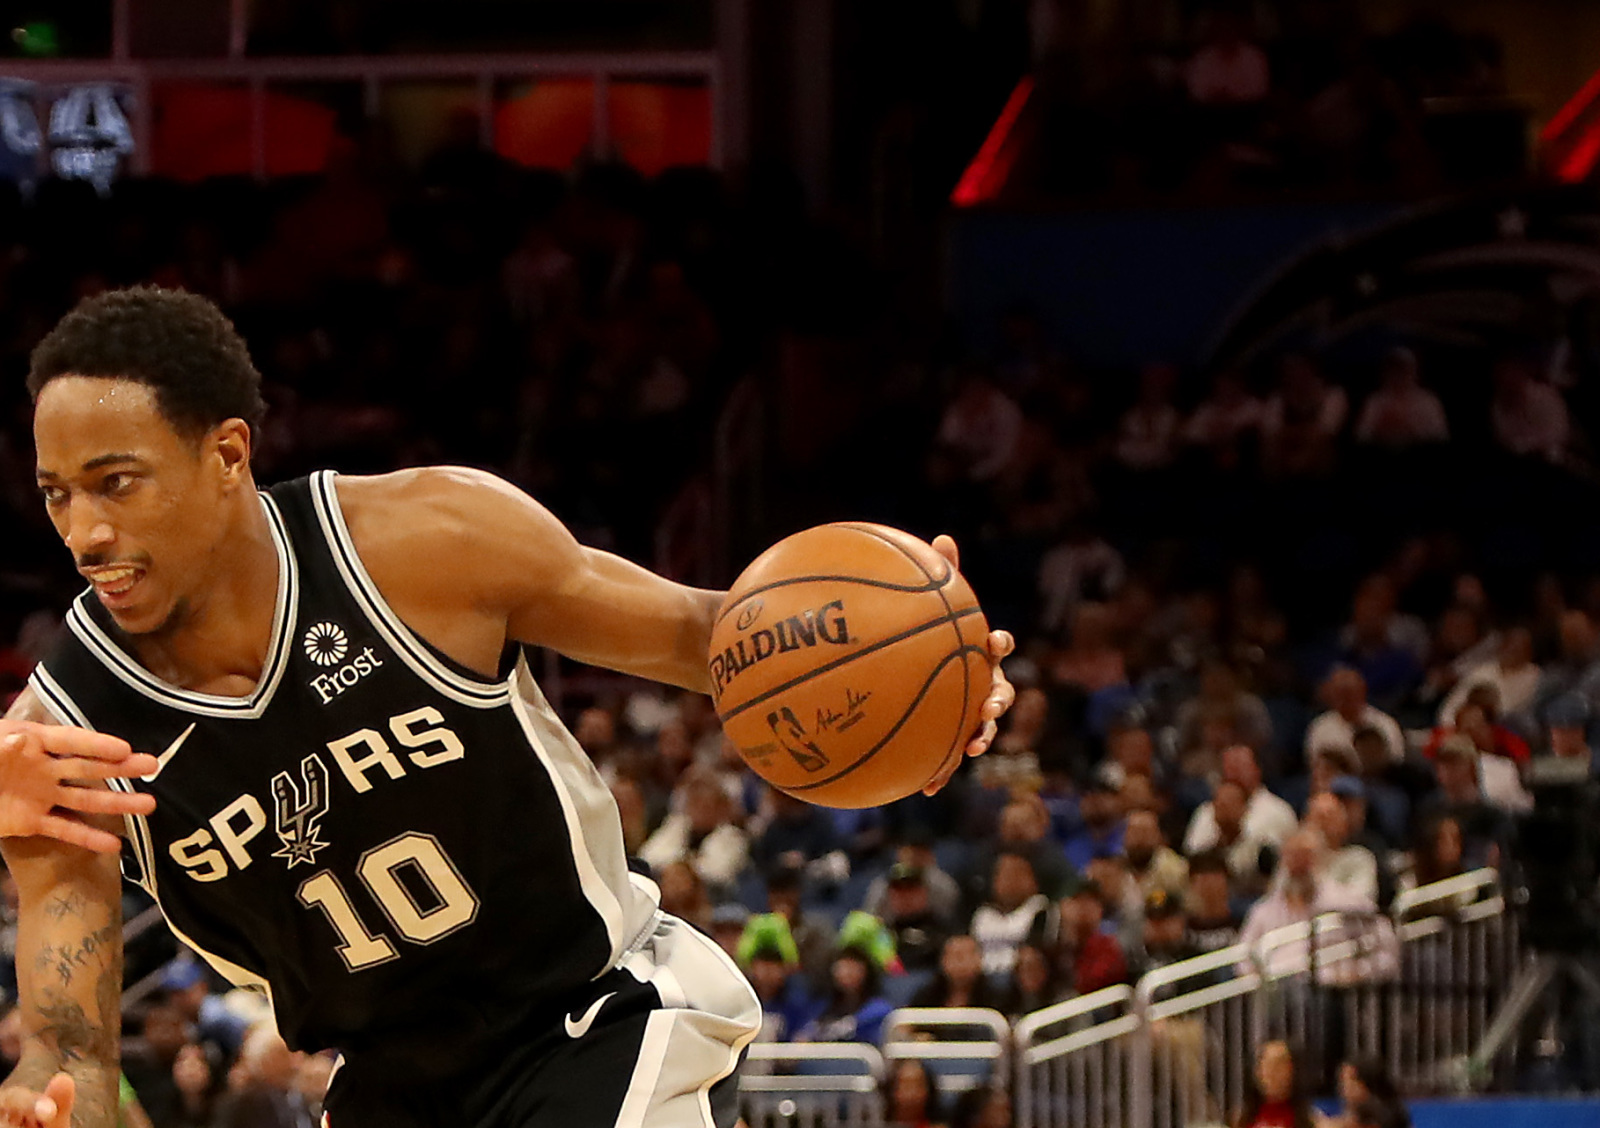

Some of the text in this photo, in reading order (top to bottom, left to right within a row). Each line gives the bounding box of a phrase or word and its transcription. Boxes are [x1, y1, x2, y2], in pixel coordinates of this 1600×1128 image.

[309, 645, 384, 705] Frost
[709, 599, 850, 702] PALDING
[168, 705, 465, 871] SPURS
[294, 830, 482, 973] 10
